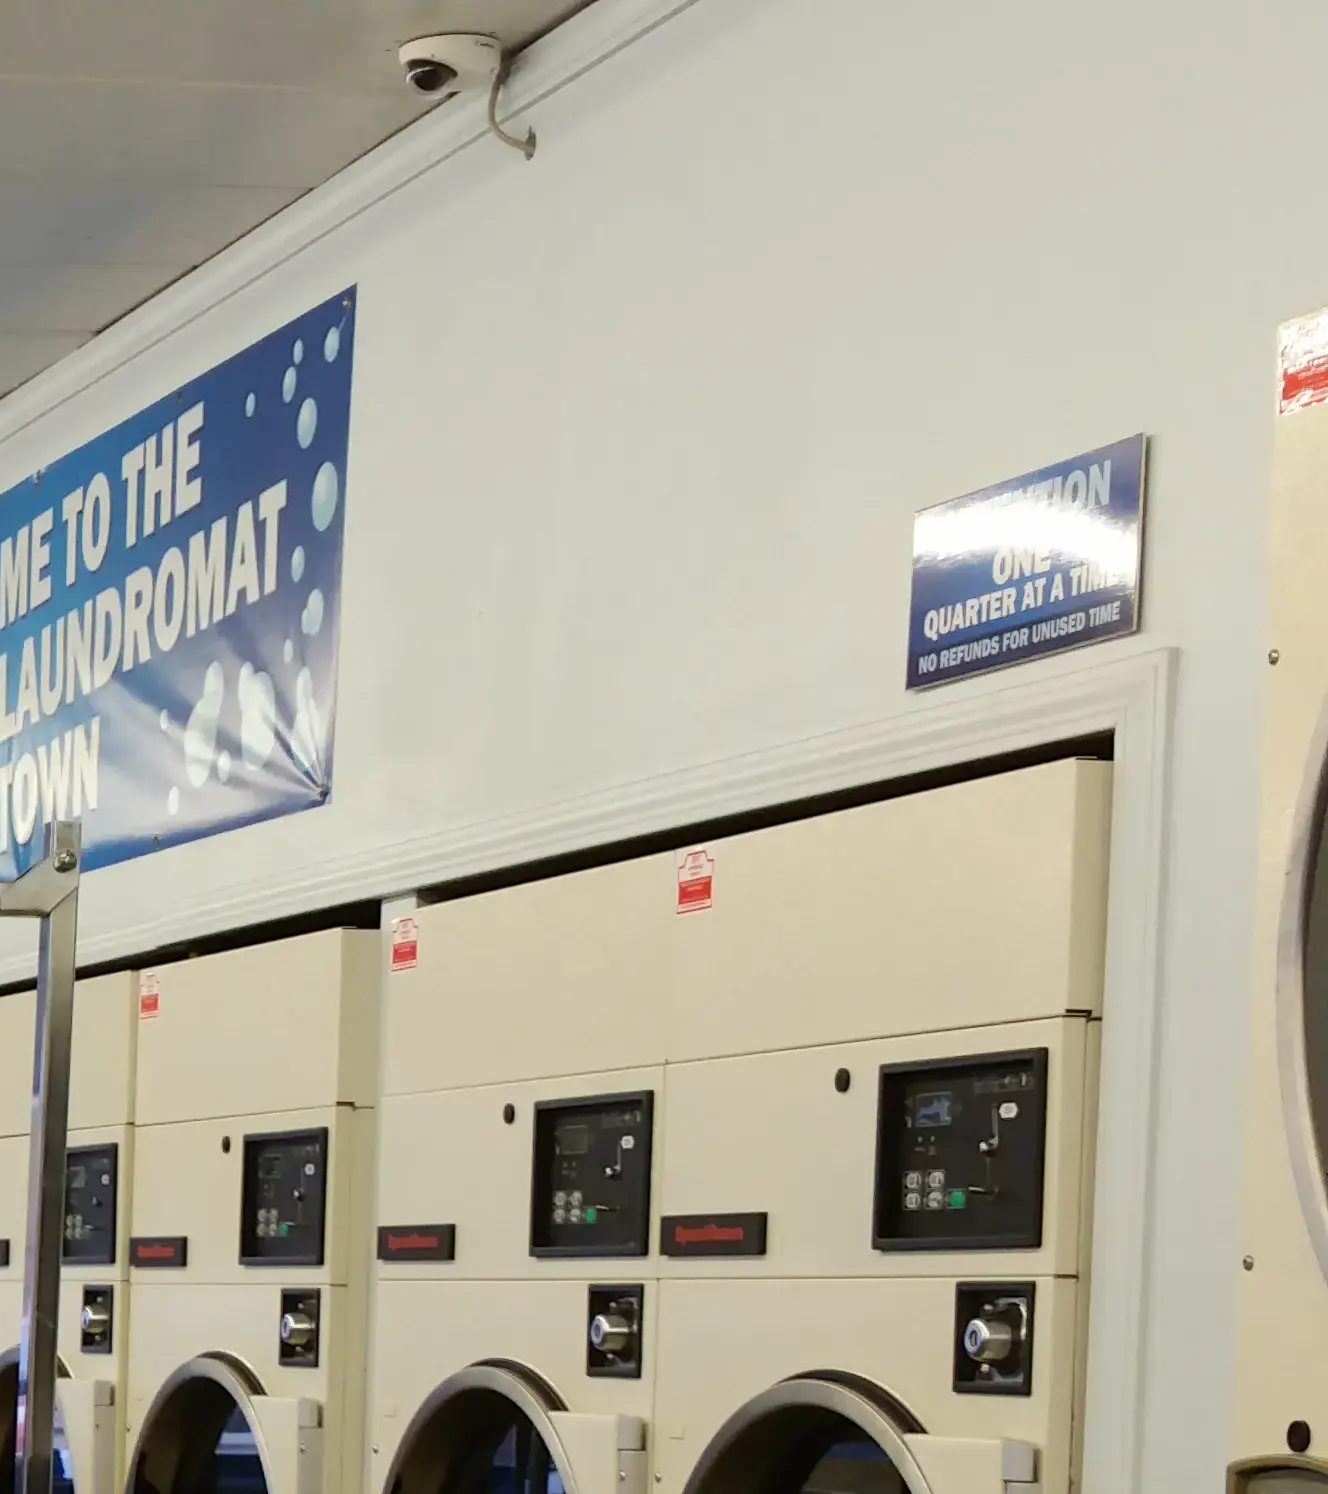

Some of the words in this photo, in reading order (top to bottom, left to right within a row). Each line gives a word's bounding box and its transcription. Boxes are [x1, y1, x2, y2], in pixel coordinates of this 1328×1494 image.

[62, 471, 111, 588] TO
[122, 400, 204, 550] THE
[918, 653, 938, 675] NO
[940, 636, 1000, 668] REFUNDS
[1002, 627, 1029, 652] FOR
[1032, 611, 1085, 643] UNUSED
[1089, 601, 1121, 628] TIME
[923, 587, 1017, 641] QUARTER
[1021, 577, 1047, 612] AT
[1050, 572, 1064, 603] A
[1070, 562, 1121, 597] TIM
